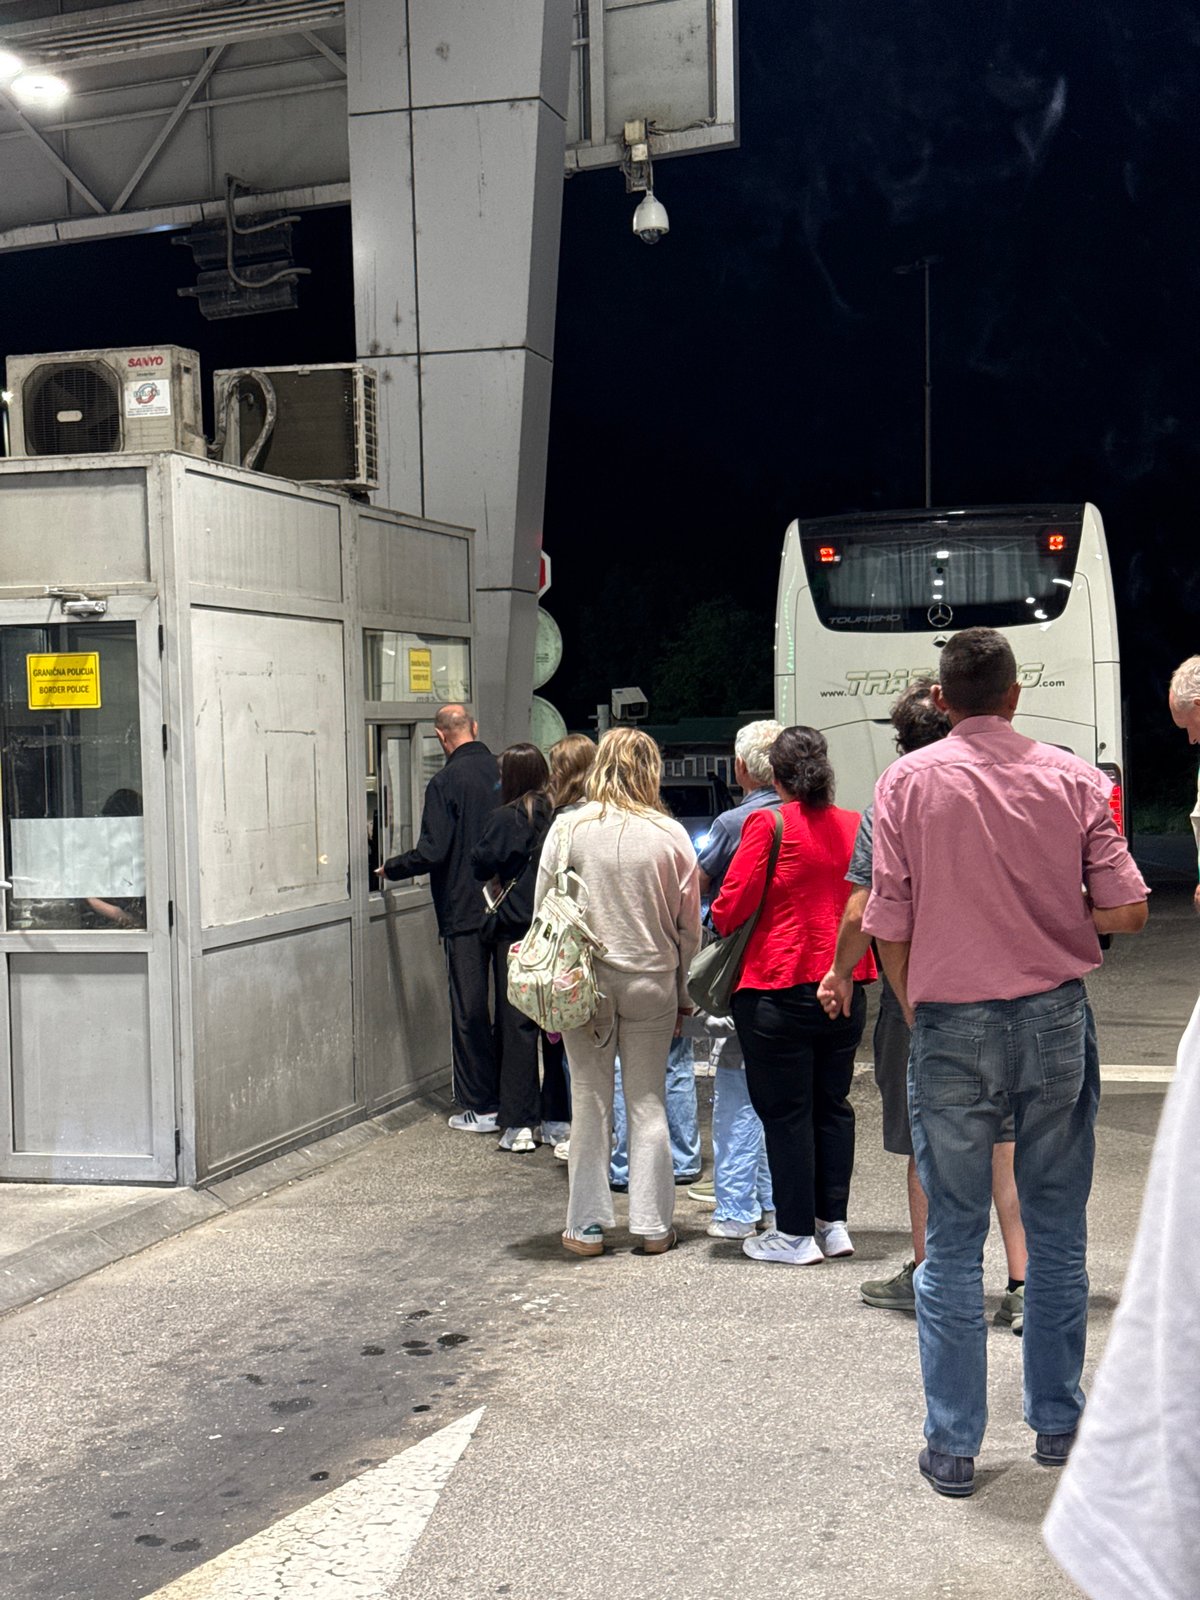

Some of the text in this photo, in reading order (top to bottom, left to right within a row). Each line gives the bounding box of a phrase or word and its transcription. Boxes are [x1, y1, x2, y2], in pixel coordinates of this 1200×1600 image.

[128, 356, 164, 368] SANYO
[828, 614, 901, 625] TOURISMO
[67, 667, 94, 676] POLICIJA
[39, 685, 89, 695] BORDER POLICE
